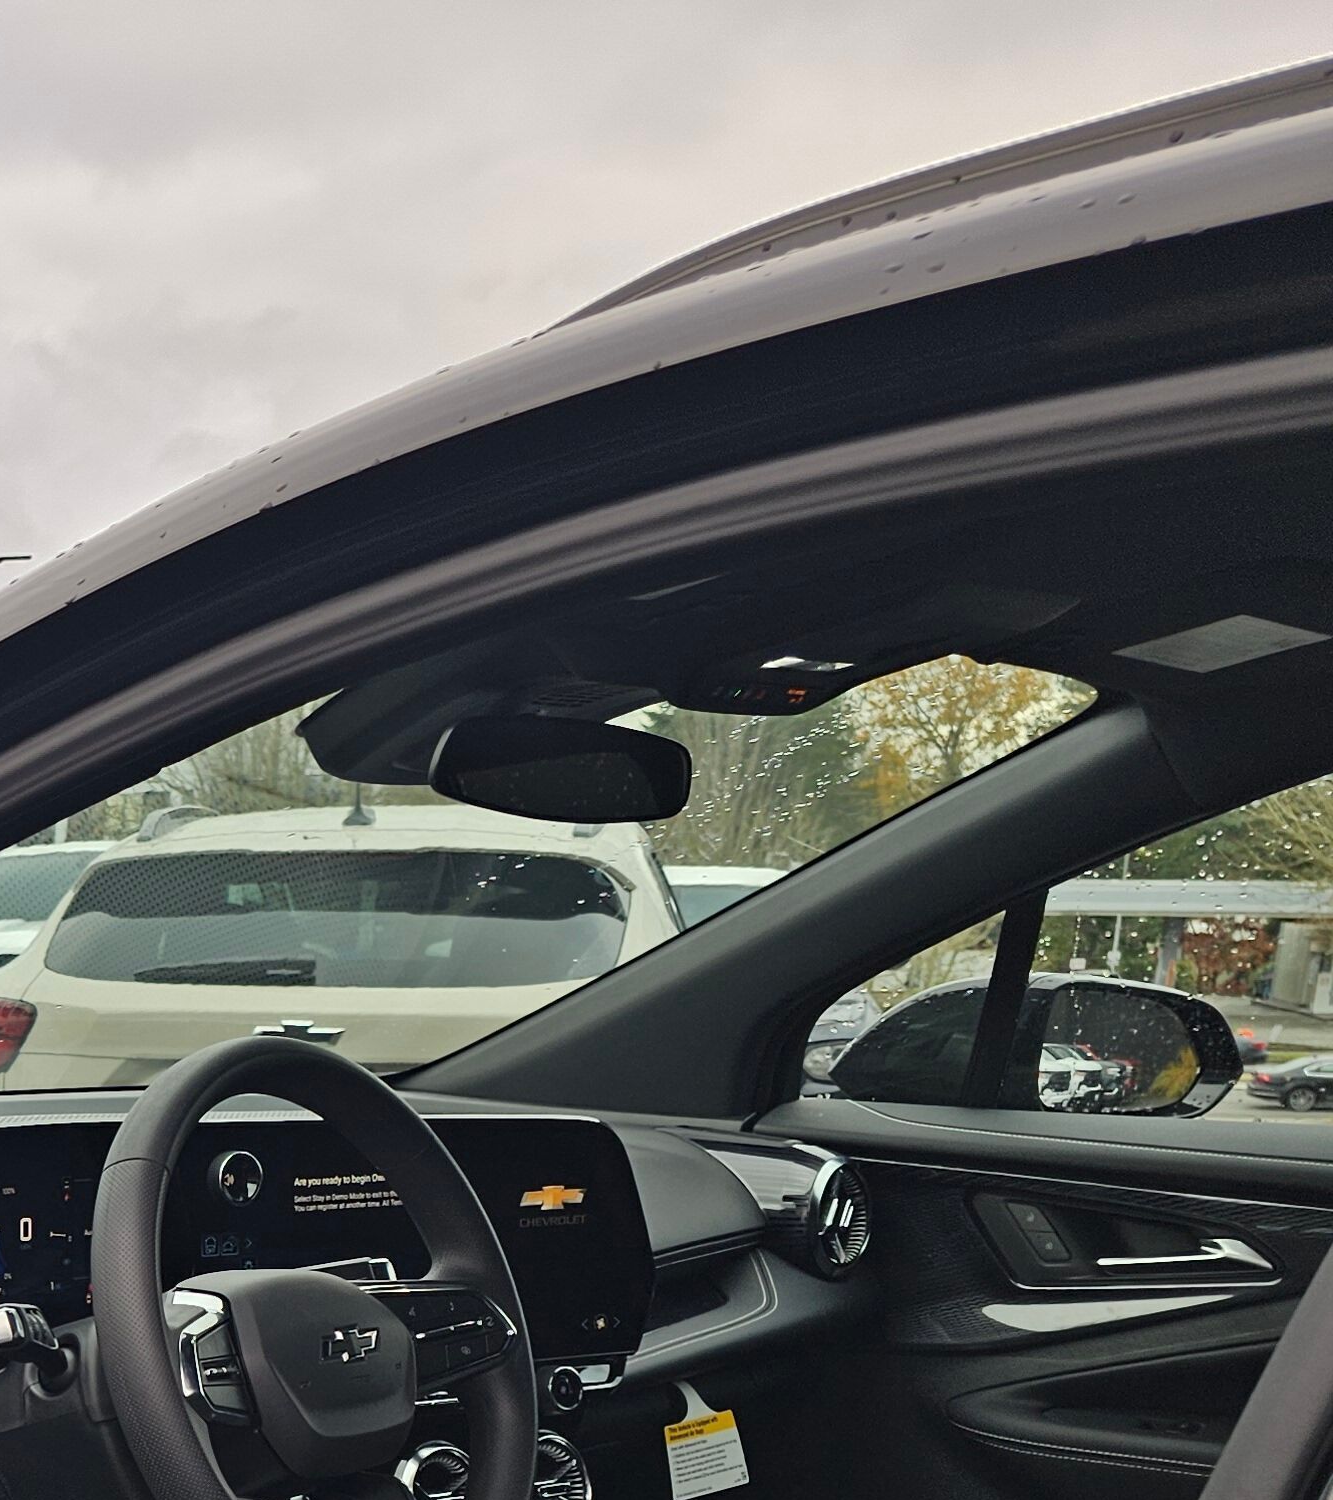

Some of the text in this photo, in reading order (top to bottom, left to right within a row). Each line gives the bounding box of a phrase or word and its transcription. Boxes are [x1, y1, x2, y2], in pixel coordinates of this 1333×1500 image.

[294, 1177, 307, 1187] Are
[307, 1178, 322, 1188] you
[322, 1175, 342, 1187] ready
[351, 1174, 371, 1186] begin
[519, 1214, 589, 1228] CHEVROLET
[19, 1217, 32, 1242] 0
